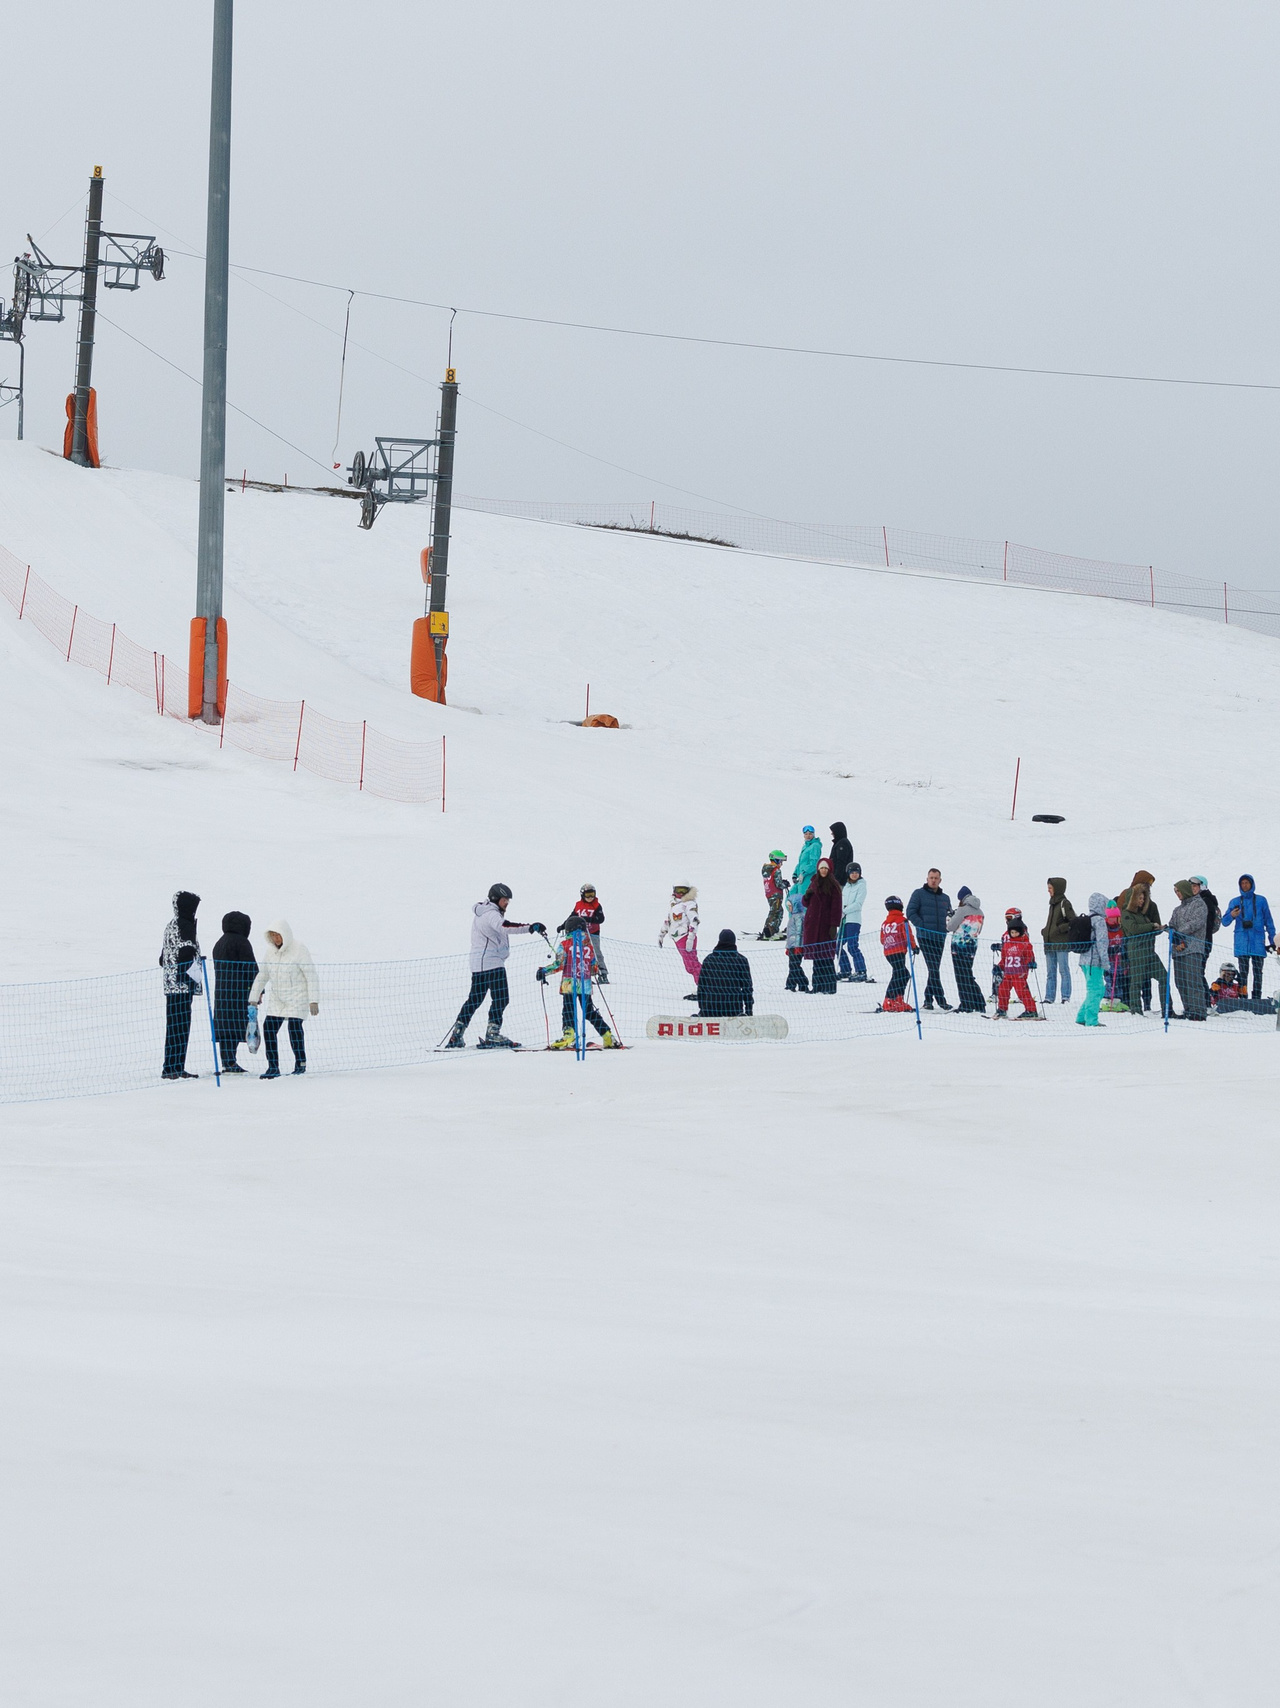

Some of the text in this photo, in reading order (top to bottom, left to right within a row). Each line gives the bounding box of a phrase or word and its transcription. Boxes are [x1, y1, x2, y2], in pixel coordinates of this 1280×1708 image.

[95, 166, 101, 177] 9
[447, 369, 454, 381] 8
[1005, 956, 1021, 967] 123
